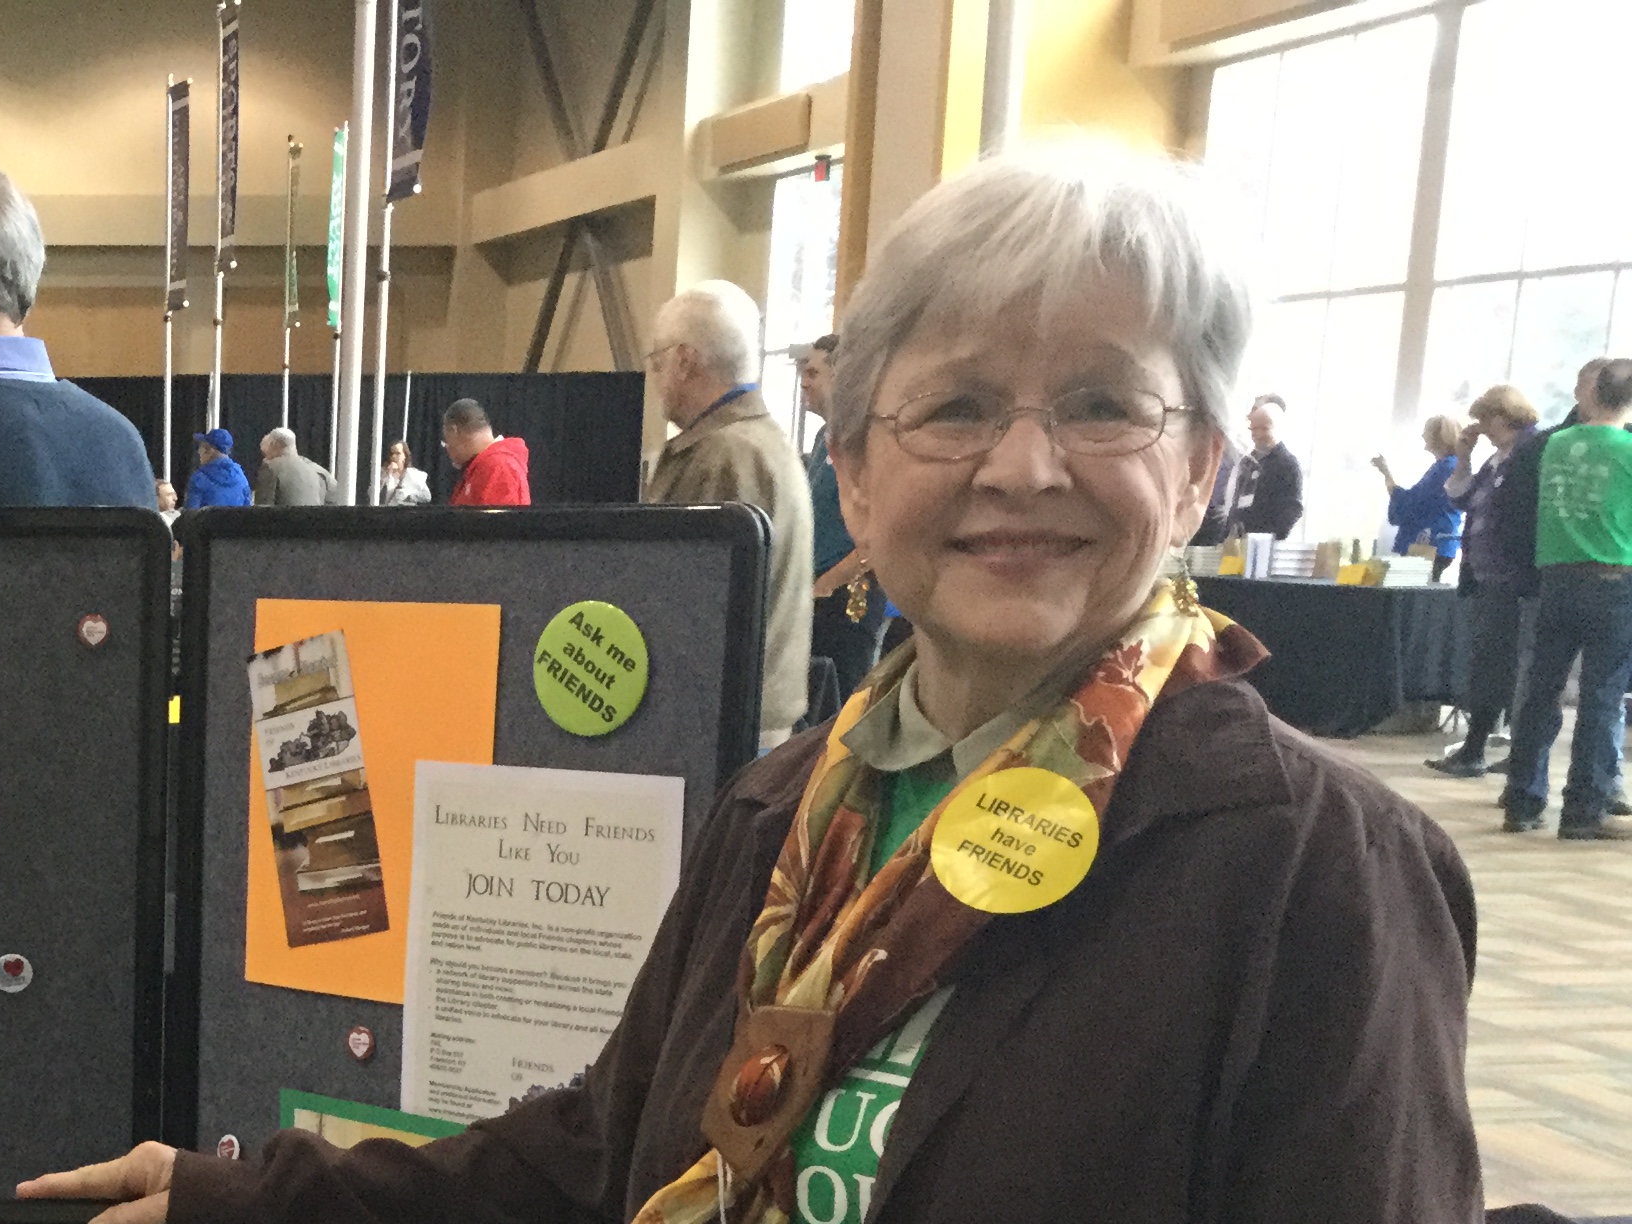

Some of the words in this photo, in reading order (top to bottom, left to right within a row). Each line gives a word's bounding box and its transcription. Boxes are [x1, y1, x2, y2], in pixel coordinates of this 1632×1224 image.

[563, 642, 616, 690] about
[568, 611, 605, 647] Ask
[606, 643, 636, 673] me
[537, 649, 617, 722] FRIENDS
[435, 804, 508, 830] LIBRARIES
[523, 812, 567, 835] NEED
[584, 816, 656, 842] FRIENDS
[976, 793, 1084, 849] LIBRARIES
[990, 827, 1037, 856] have
[498, 838, 530, 861] LIKE
[547, 843, 581, 865] YOU
[957, 839, 1044, 887] FRIENDS
[466, 873, 514, 899] JOIN
[531, 879, 611, 907] TODAY
